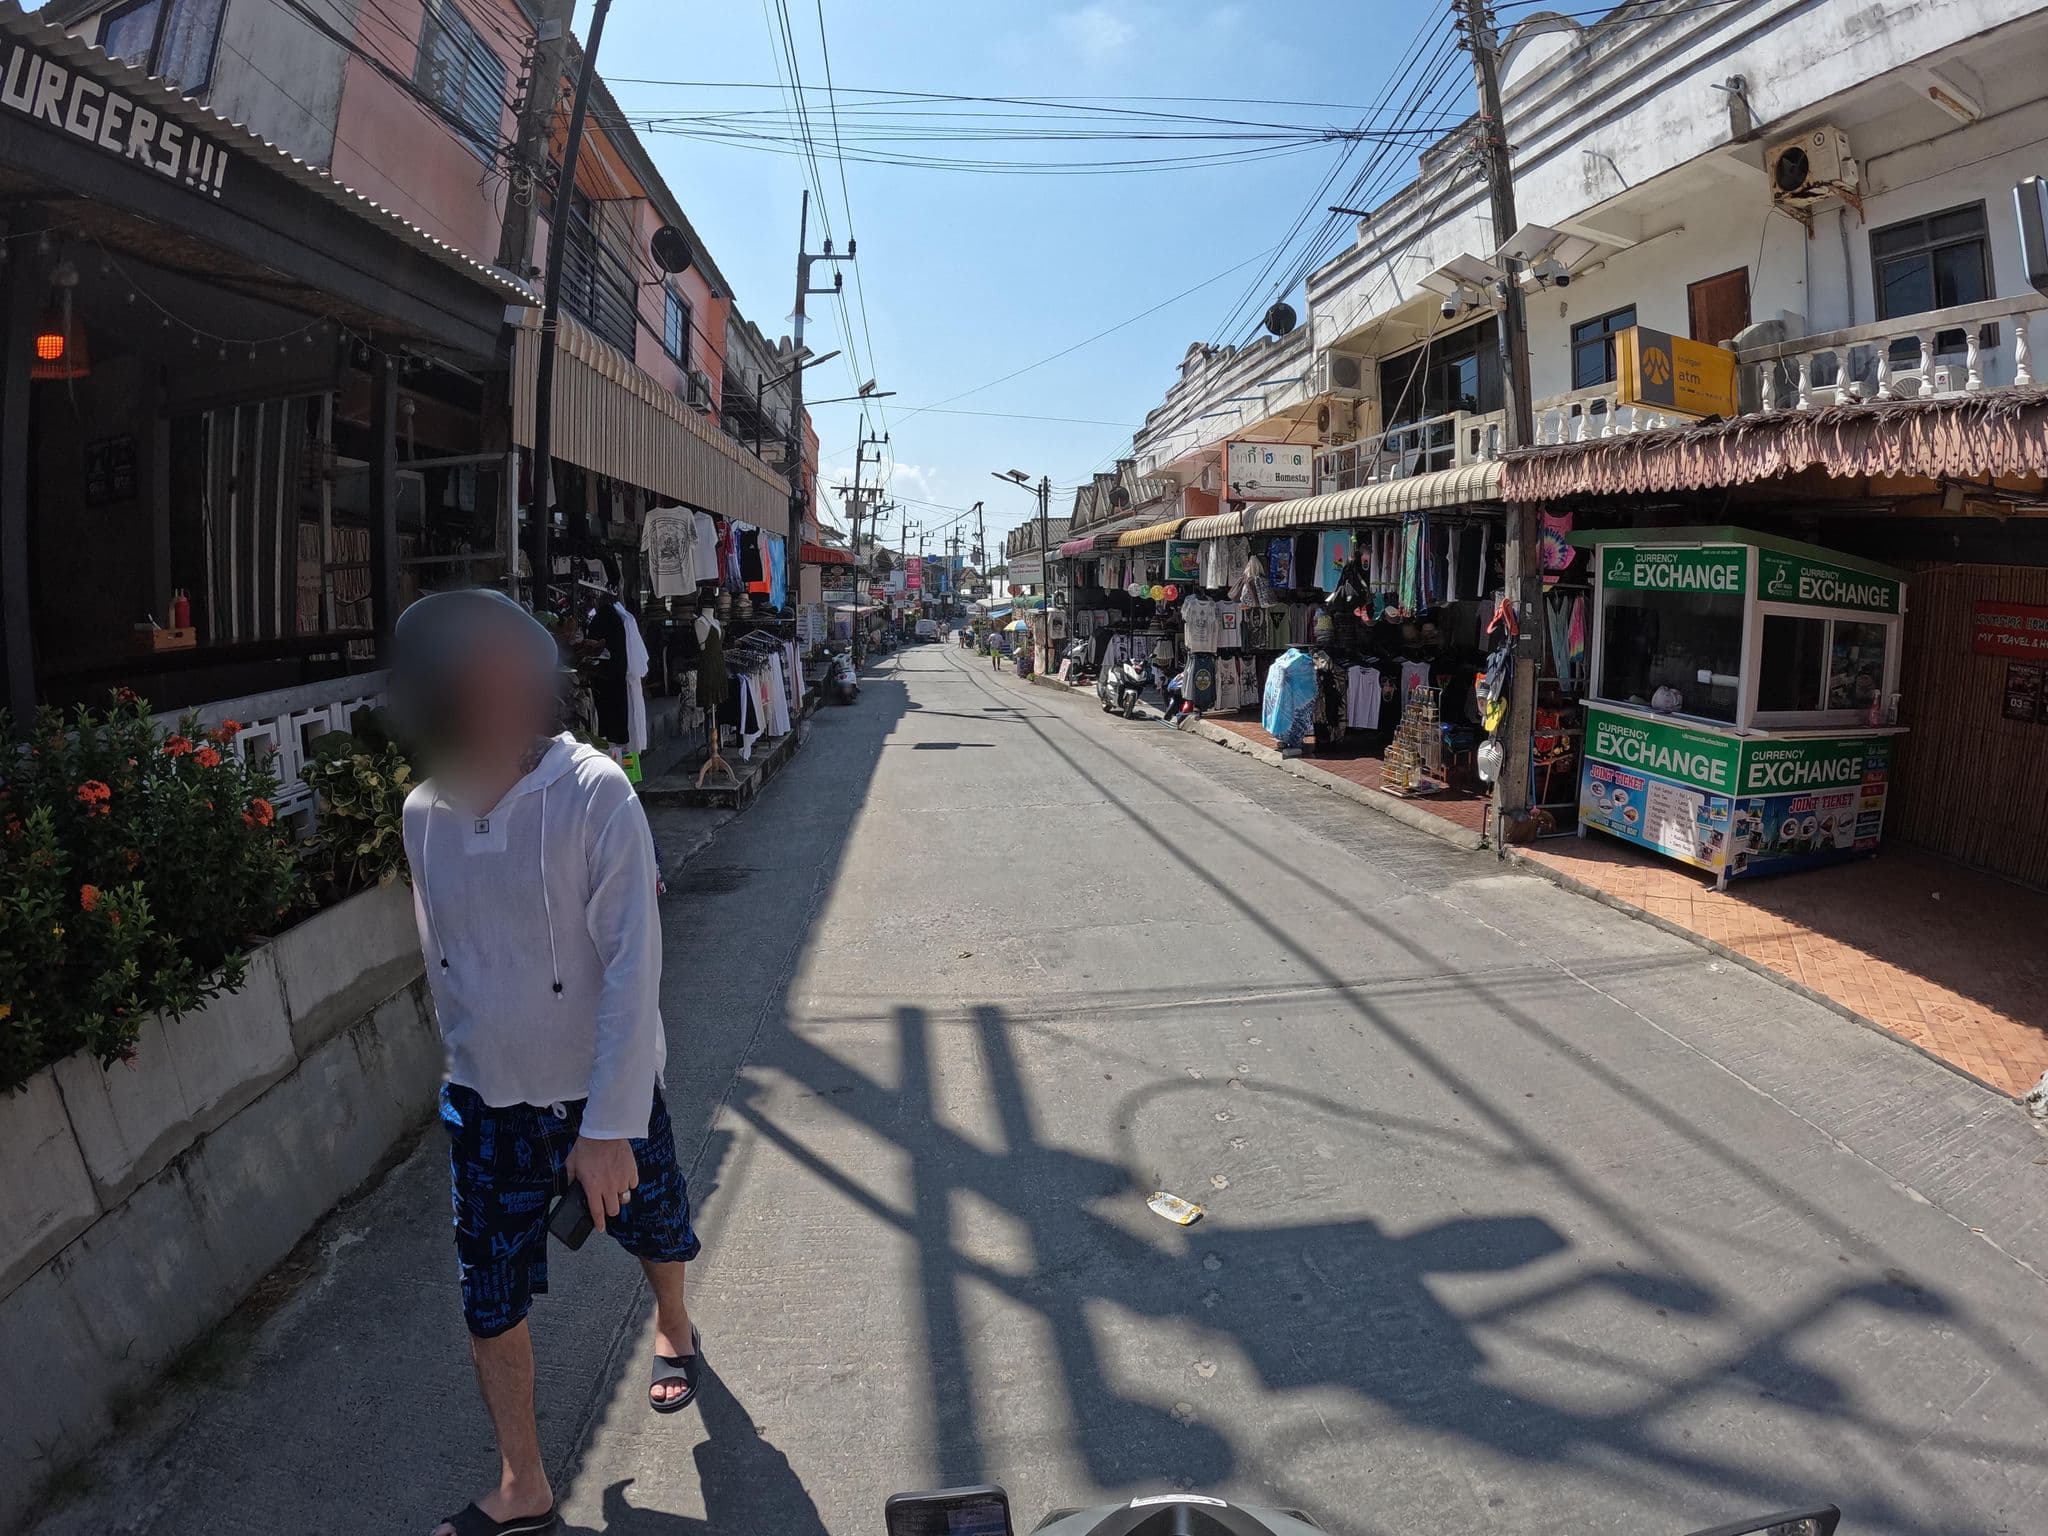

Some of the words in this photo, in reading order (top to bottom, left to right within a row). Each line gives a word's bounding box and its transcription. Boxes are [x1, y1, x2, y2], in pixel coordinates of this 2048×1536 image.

[0, 37, 228, 199] URGERS!!!
[1679, 371, 1700, 384] atm
[1275, 473, 1310, 484] Homestay
[1636, 554, 1678, 563] CURRENCY
[1634, 564, 1739, 590] EXCHANGE
[1800, 567, 1840, 580] CURRENCY
[1799, 577, 1890, 608] EXCHANGE
[1977, 632, 1994, 643] MY
[1996, 633, 2031, 648] TRAVEL
[2031, 638, 2038, 648] &
[2010, 698, 2023, 708] 03
[1598, 722, 1650, 741] CURRENCY
[1596, 731, 1728, 786] EXCHANGE
[1751, 750, 1805, 761] CURRENCY
[1590, 764, 1615, 784] JOINT
[1615, 771, 1645, 791] TICKET
[1748, 757, 1864, 788] EXCHANGE
[1789, 797, 1819, 813] JOINT
[1821, 793, 1854, 809] TICKET
